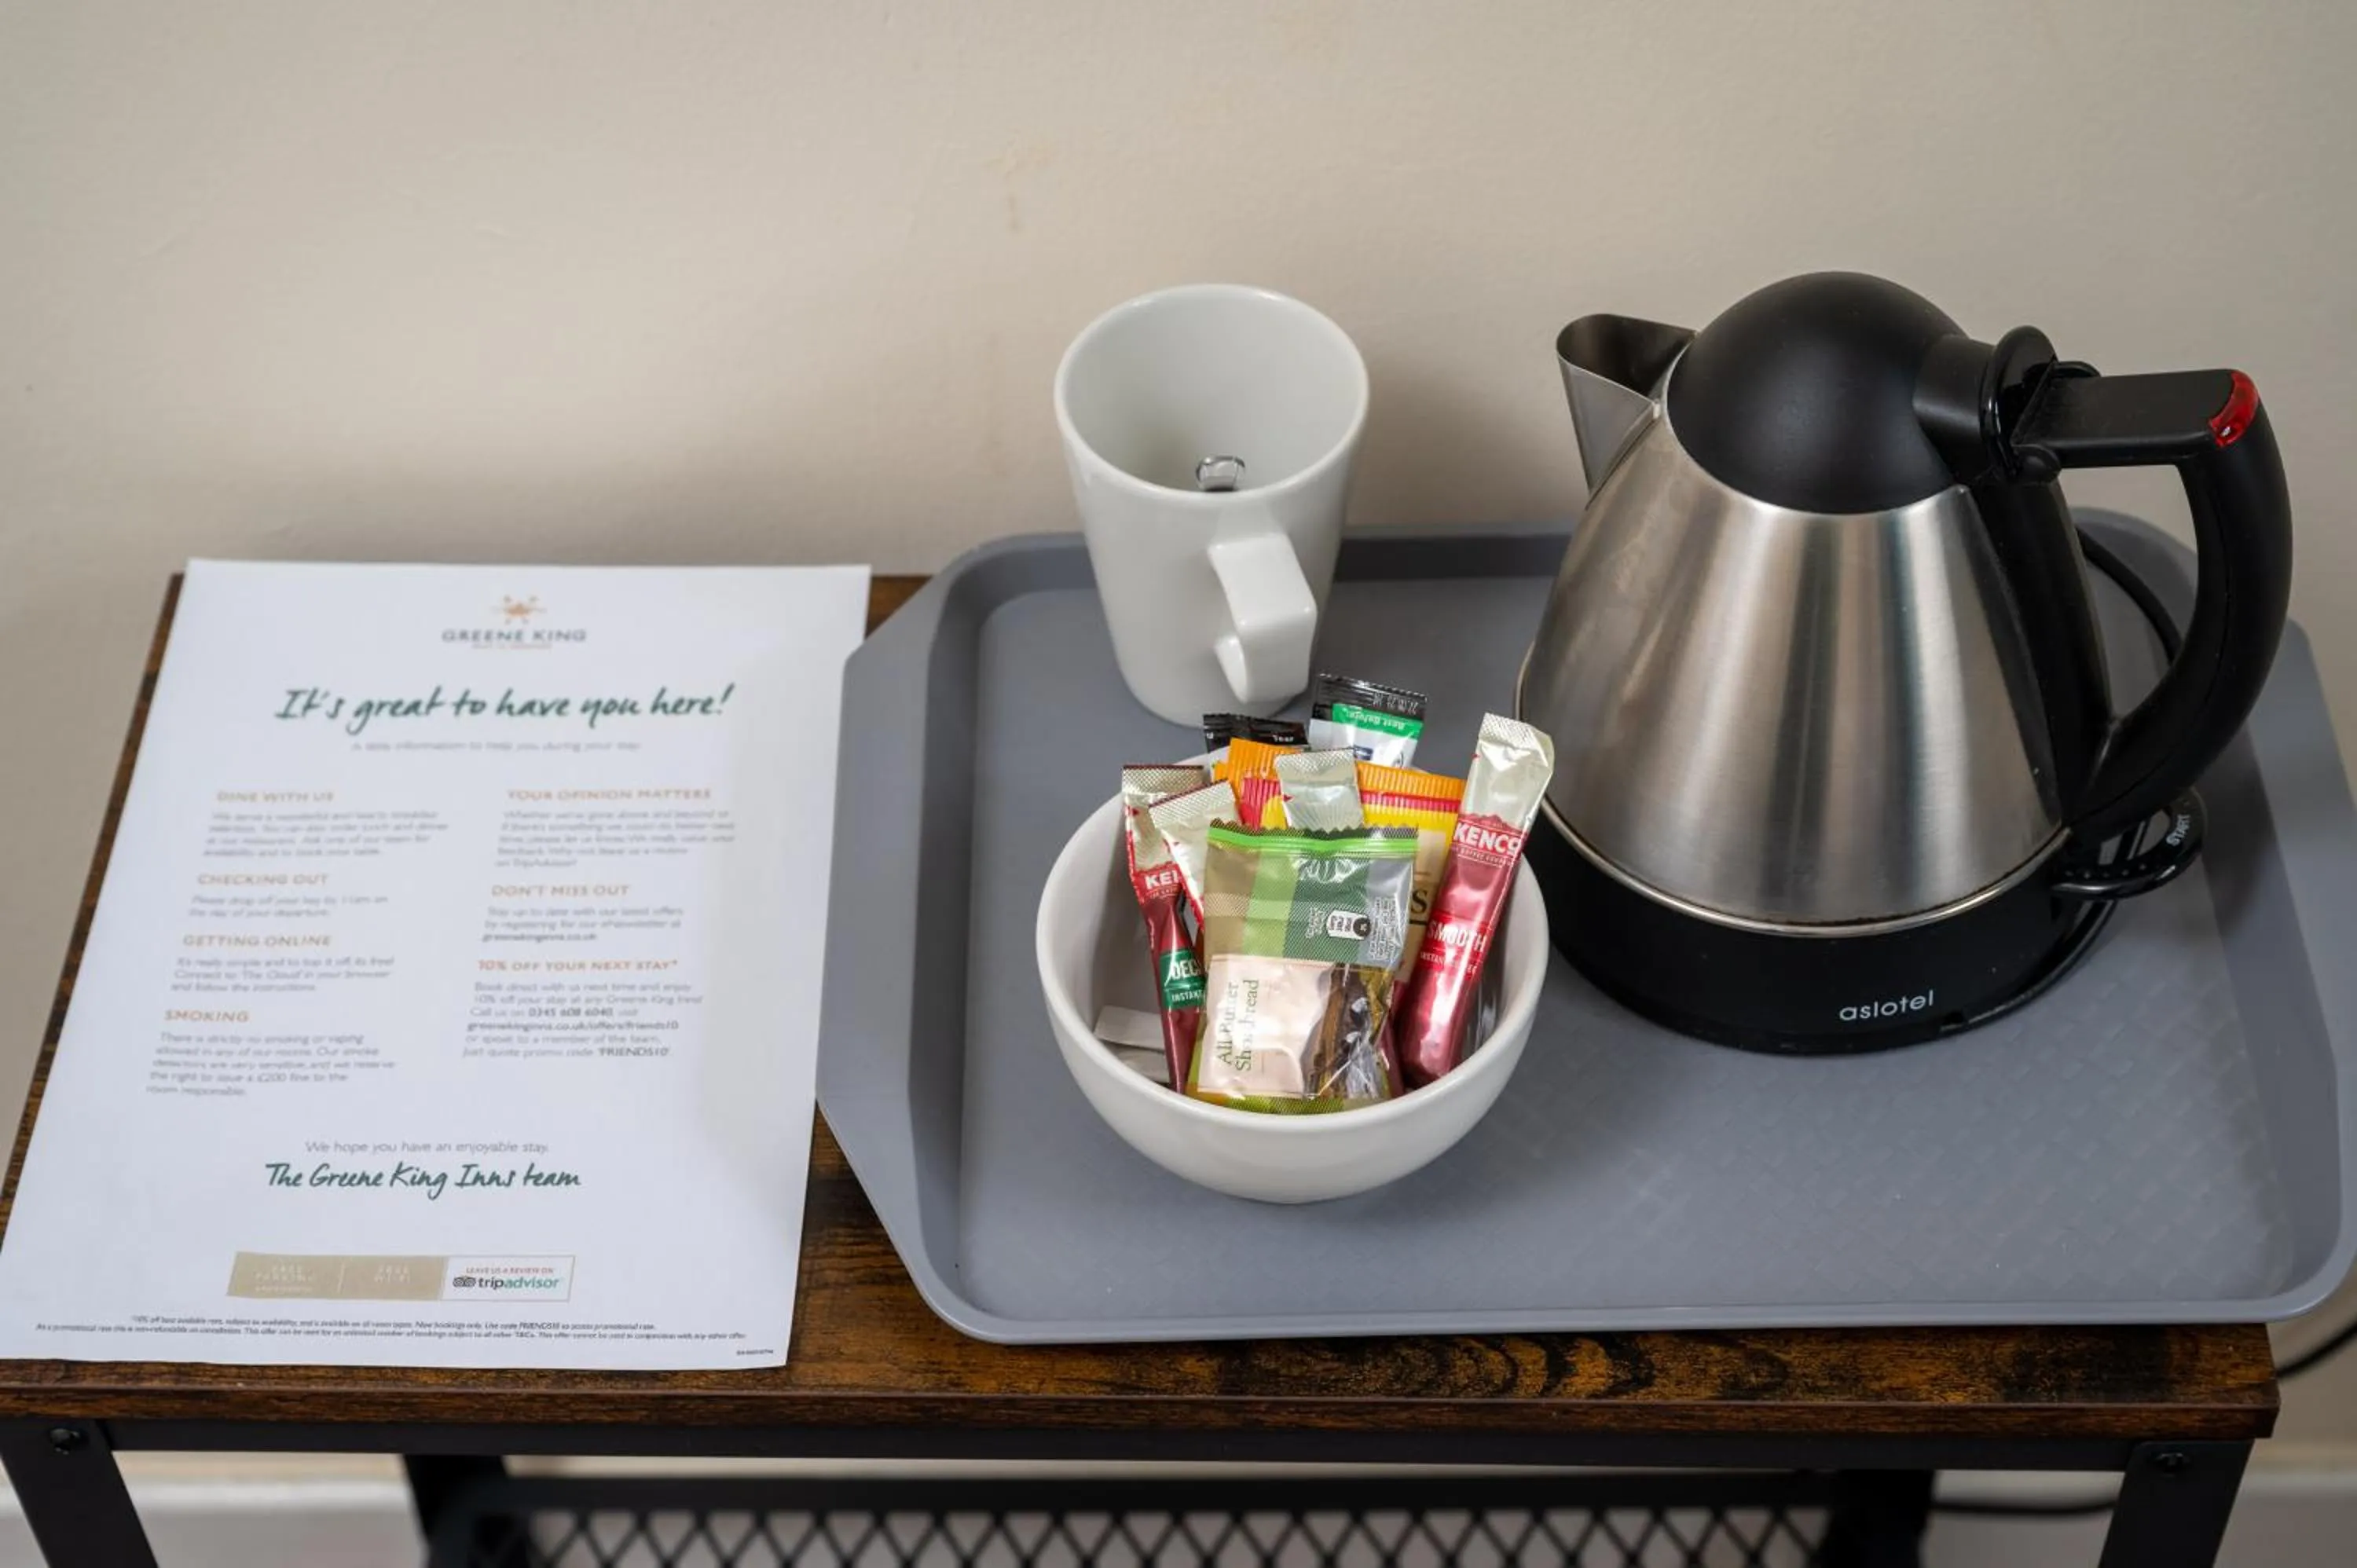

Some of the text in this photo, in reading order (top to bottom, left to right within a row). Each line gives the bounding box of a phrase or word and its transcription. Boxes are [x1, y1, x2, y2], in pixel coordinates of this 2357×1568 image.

[442, 629, 587, 643] GREENE KING
[274, 682, 736, 736] It's great to have you here!
[508, 789, 710, 800] YOUR OPINION MATTERS
[197, 874, 328, 886] CHECKING OUT
[182, 934, 332, 947] GETTING ONLINE
[478, 960, 507, 971] 10%
[511, 962, 540, 972] OFF
[546, 961, 586, 972] YOUR
[590, 961, 632, 971] NEXT
[1839, 989, 1934, 1020] aslotel
[164, 1009, 250, 1023] SMOKING
[1216, 982, 1239, 1066] All Buer
[304, 1141, 331, 1153] We
[333, 1141, 368, 1155] hope
[372, 1143, 397, 1155] you
[401, 1141, 431, 1153] have
[435, 1143, 453, 1153] an
[455, 1141, 519, 1155] enjoyable
[265, 1160, 582, 1201] The Greene King Inns team
[478, 1276, 560, 1290] tripadvisor
